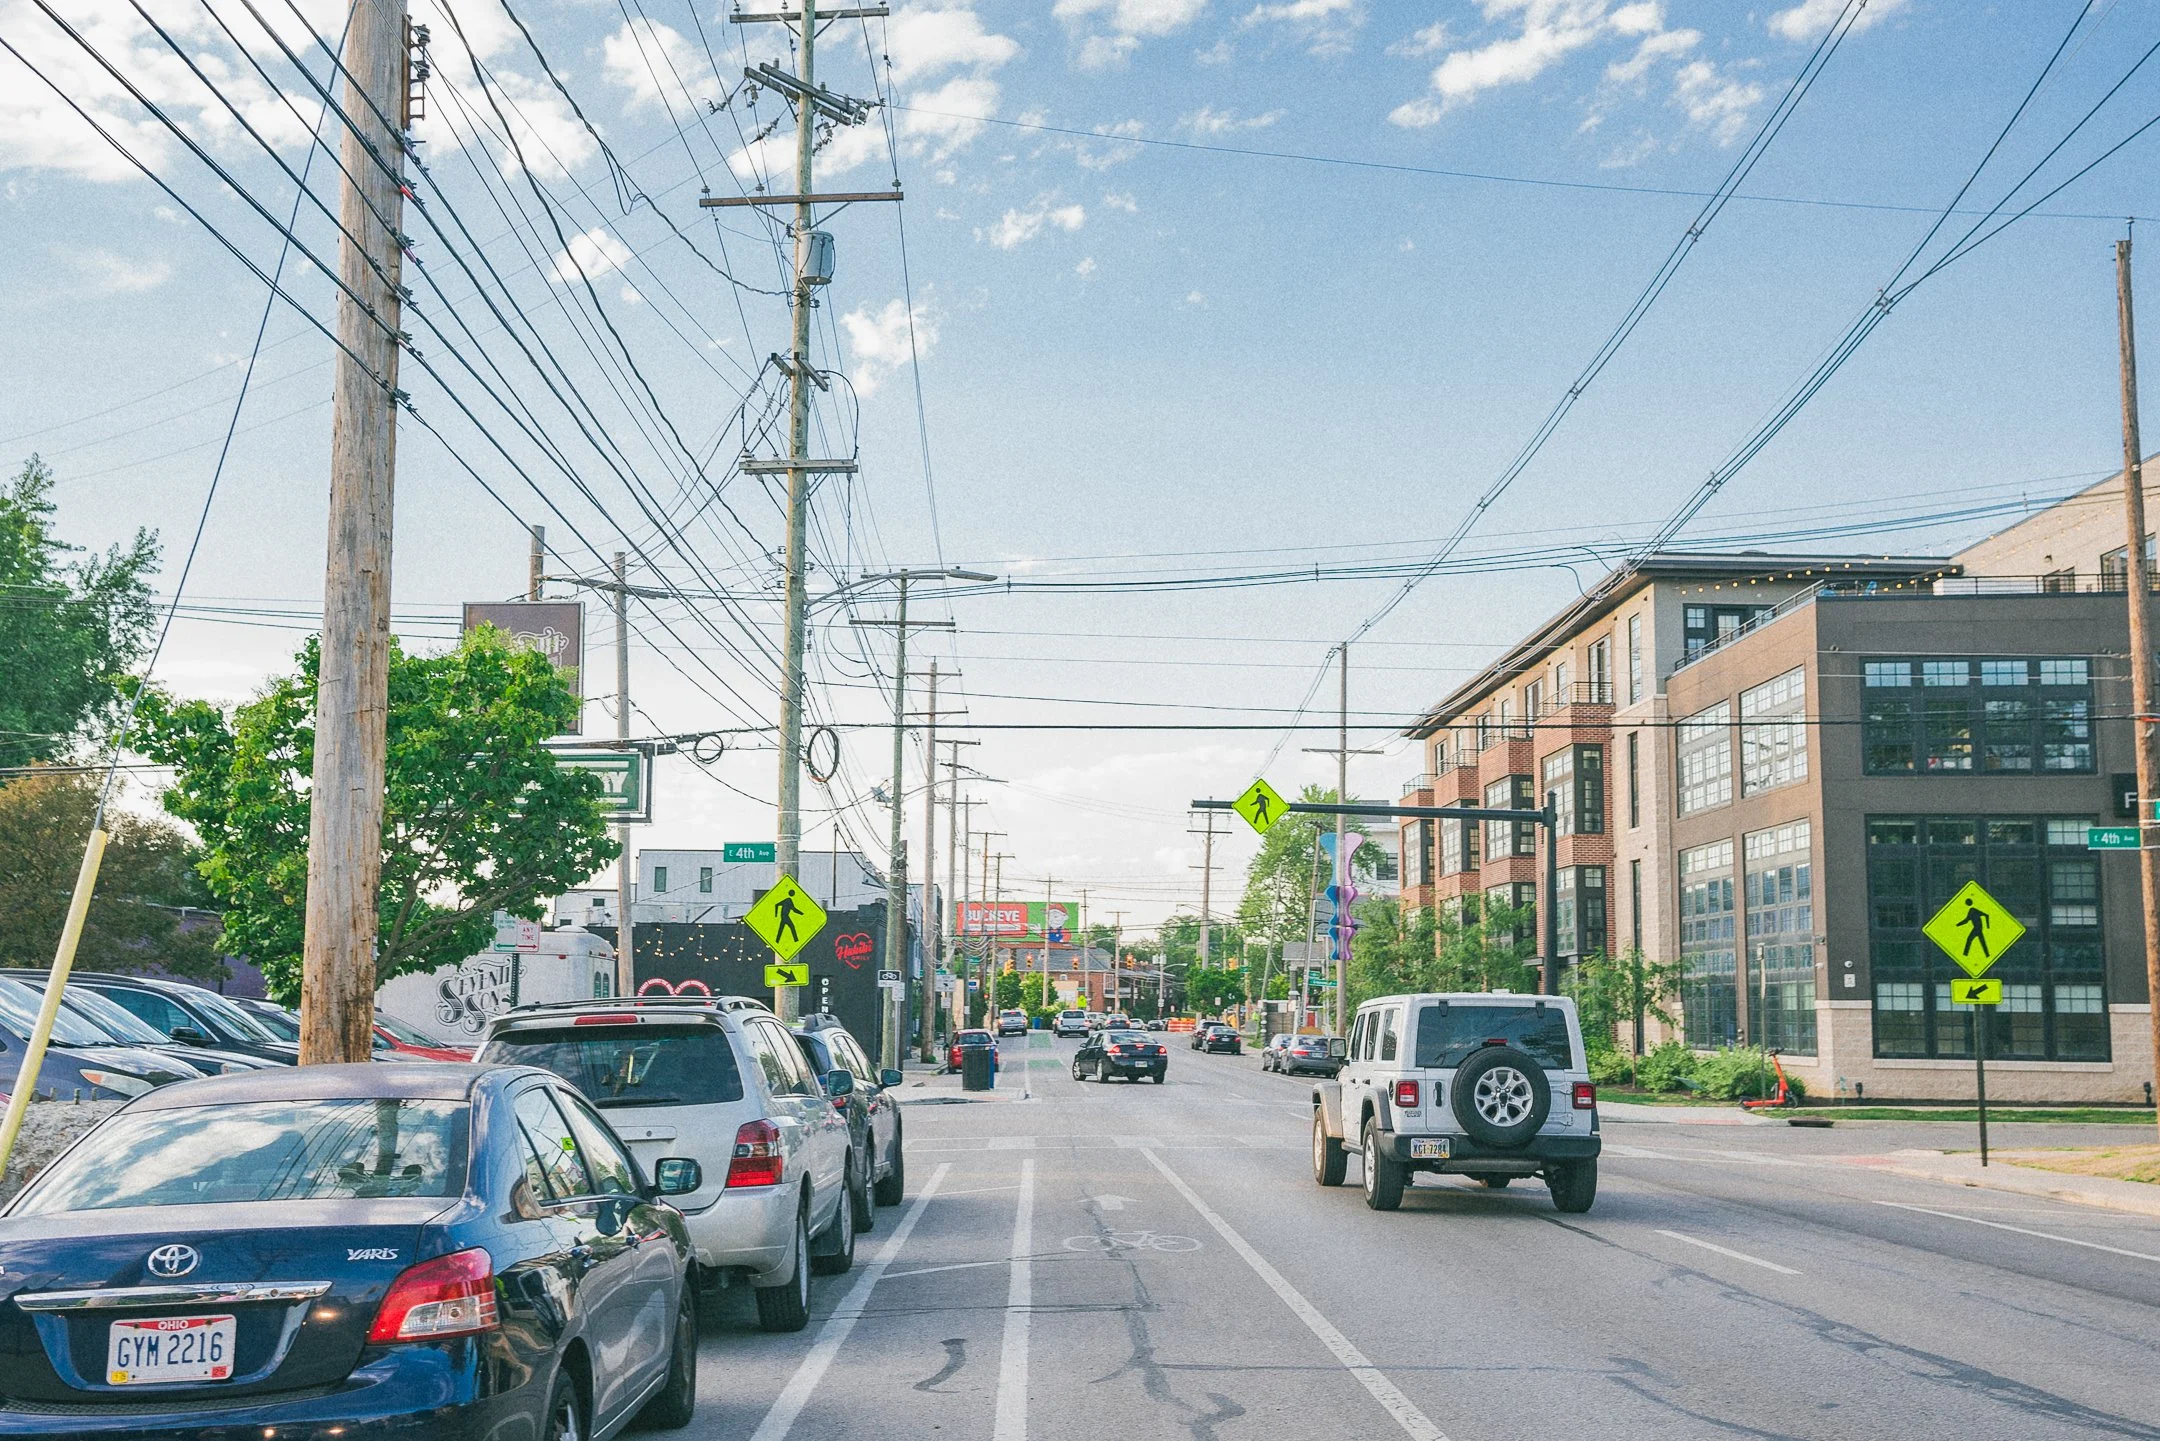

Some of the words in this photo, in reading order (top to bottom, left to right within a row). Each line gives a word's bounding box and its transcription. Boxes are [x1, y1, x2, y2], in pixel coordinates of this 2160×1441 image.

[2101, 832, 2120, 844] 4th
[735, 847, 755, 859] 4th
[157, 1319, 190, 1331] OHIO
[117, 1334, 160, 1368] GYM
[166, 1331, 225, 1365] 2216
